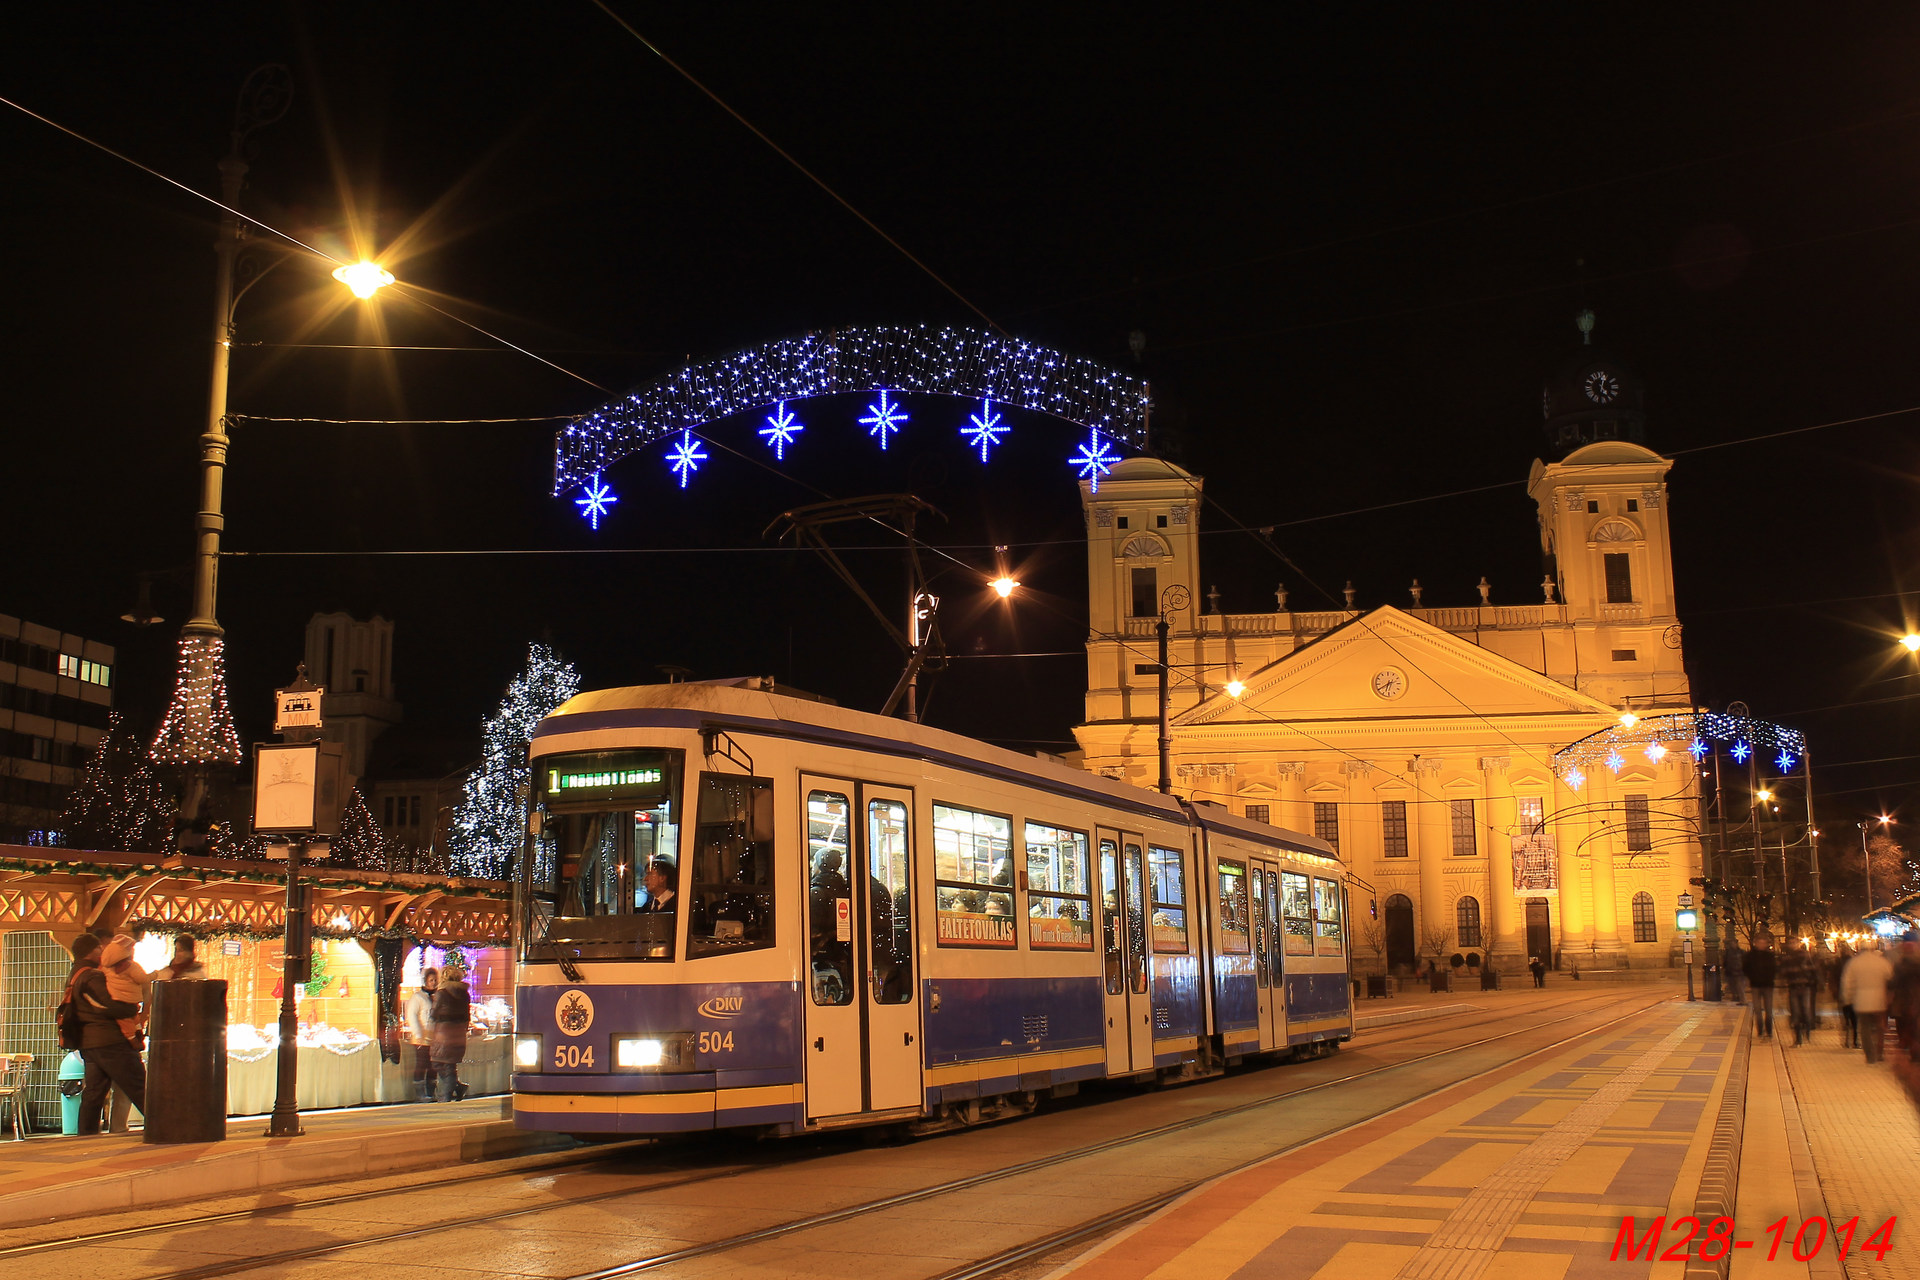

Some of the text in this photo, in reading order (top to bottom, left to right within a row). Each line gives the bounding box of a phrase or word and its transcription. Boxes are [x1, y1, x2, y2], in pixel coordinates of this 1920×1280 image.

[287, 714, 309, 726] MM
[548, 769, 561, 793] 1
[939, 916, 1013, 942] FALTETOVÁLÁS
[715, 997, 743, 1011] DKV
[699, 1031, 735, 1053] 504
[555, 1045, 595, 1068] 504
